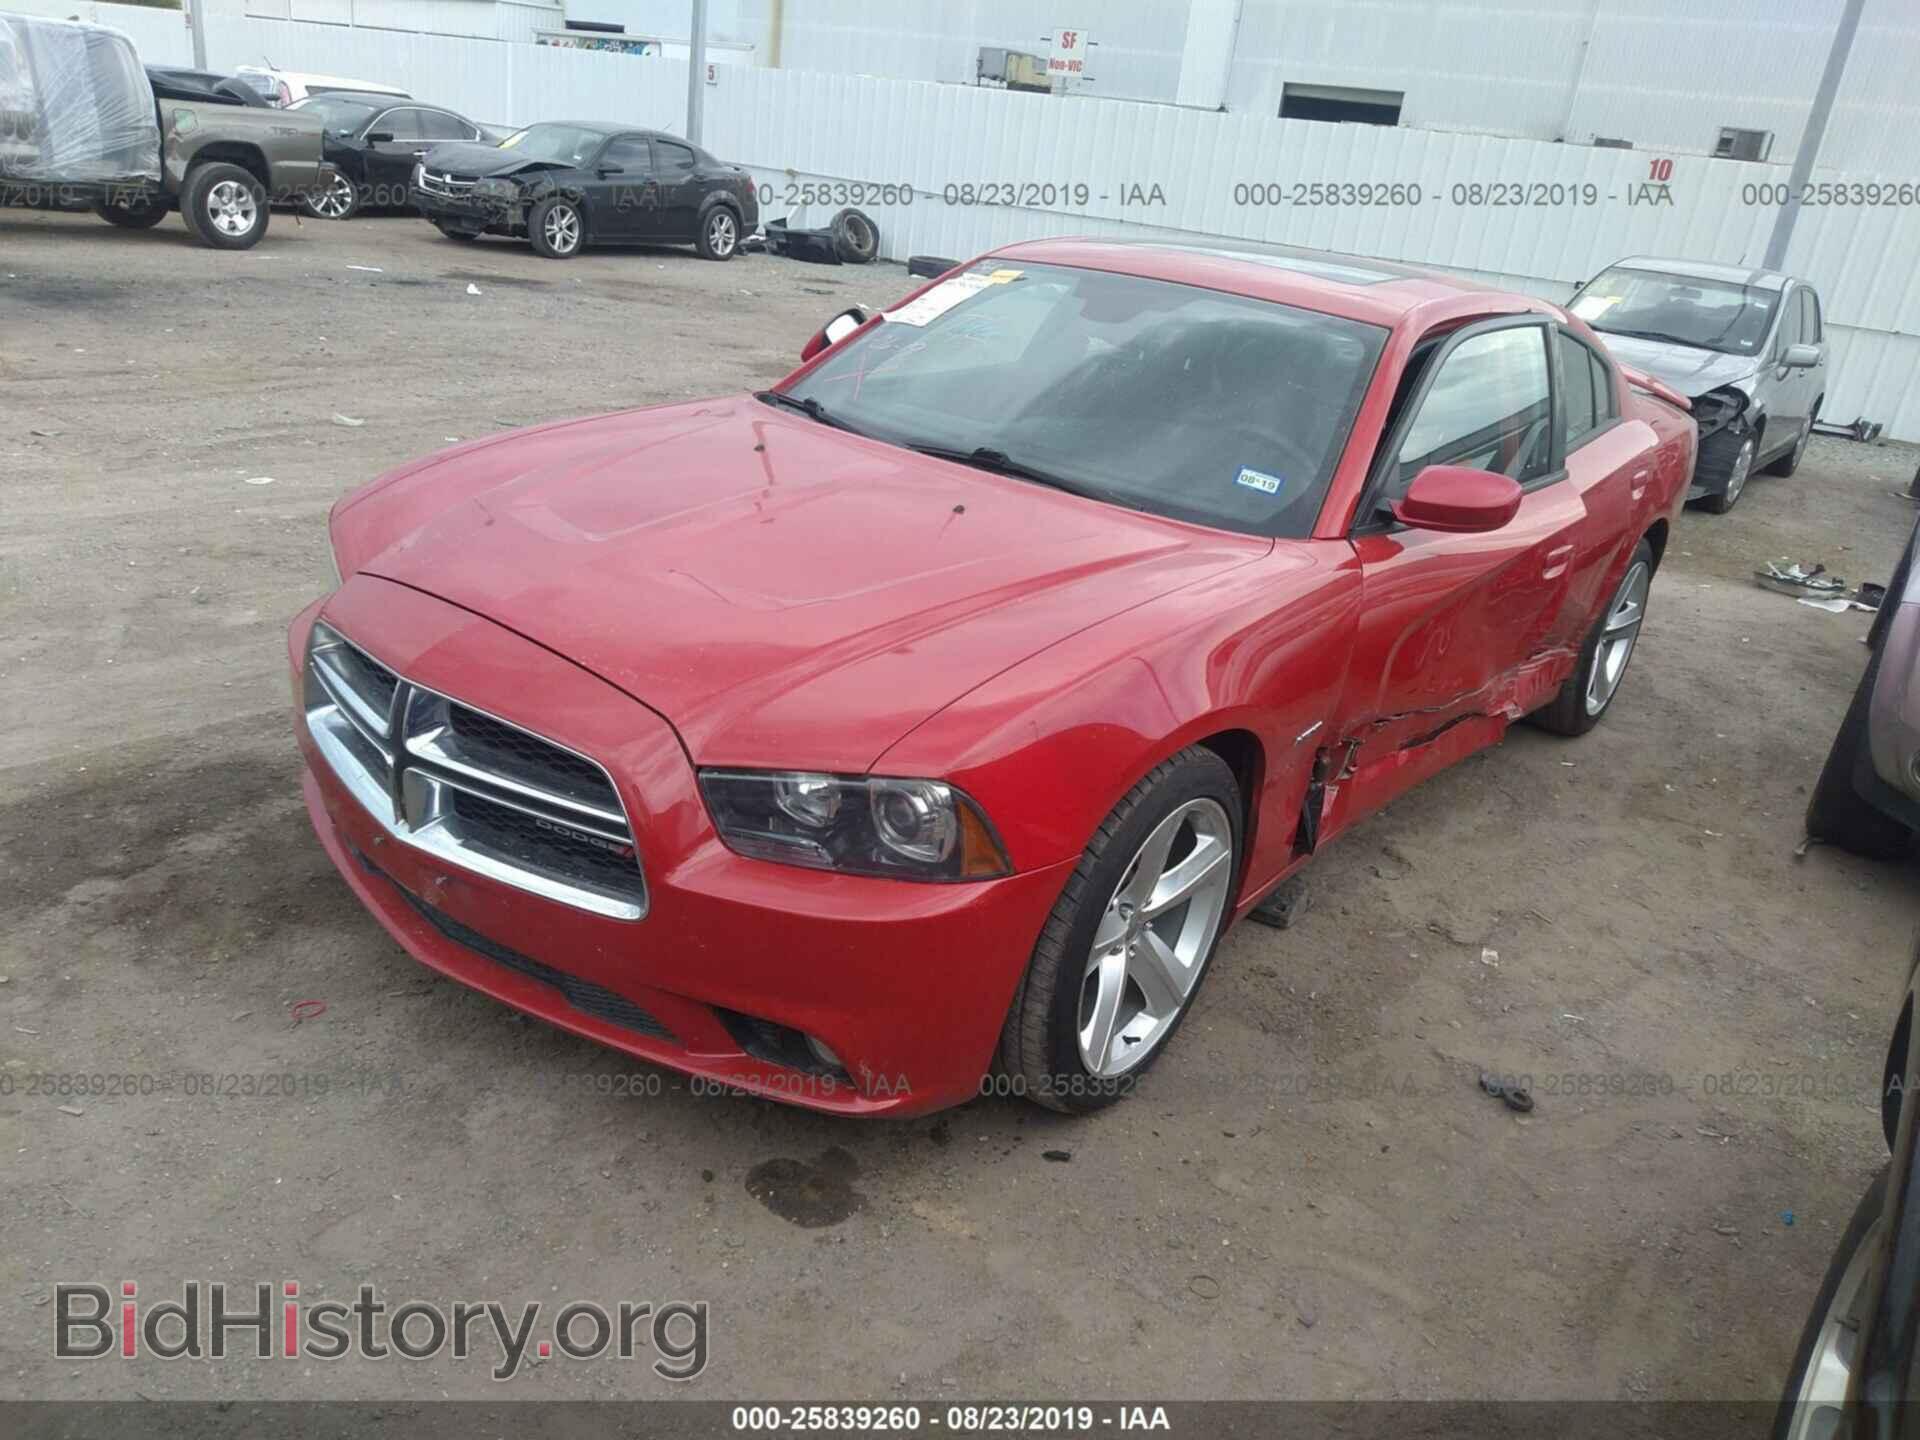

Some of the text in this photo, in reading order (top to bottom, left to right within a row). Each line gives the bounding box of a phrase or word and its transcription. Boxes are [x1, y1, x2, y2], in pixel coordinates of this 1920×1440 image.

[1062, 31, 1077, 49] SF
[708, 64, 714, 80] 5
[1649, 159, 1673, 182] 10
[536, 819, 625, 856] DODGE
